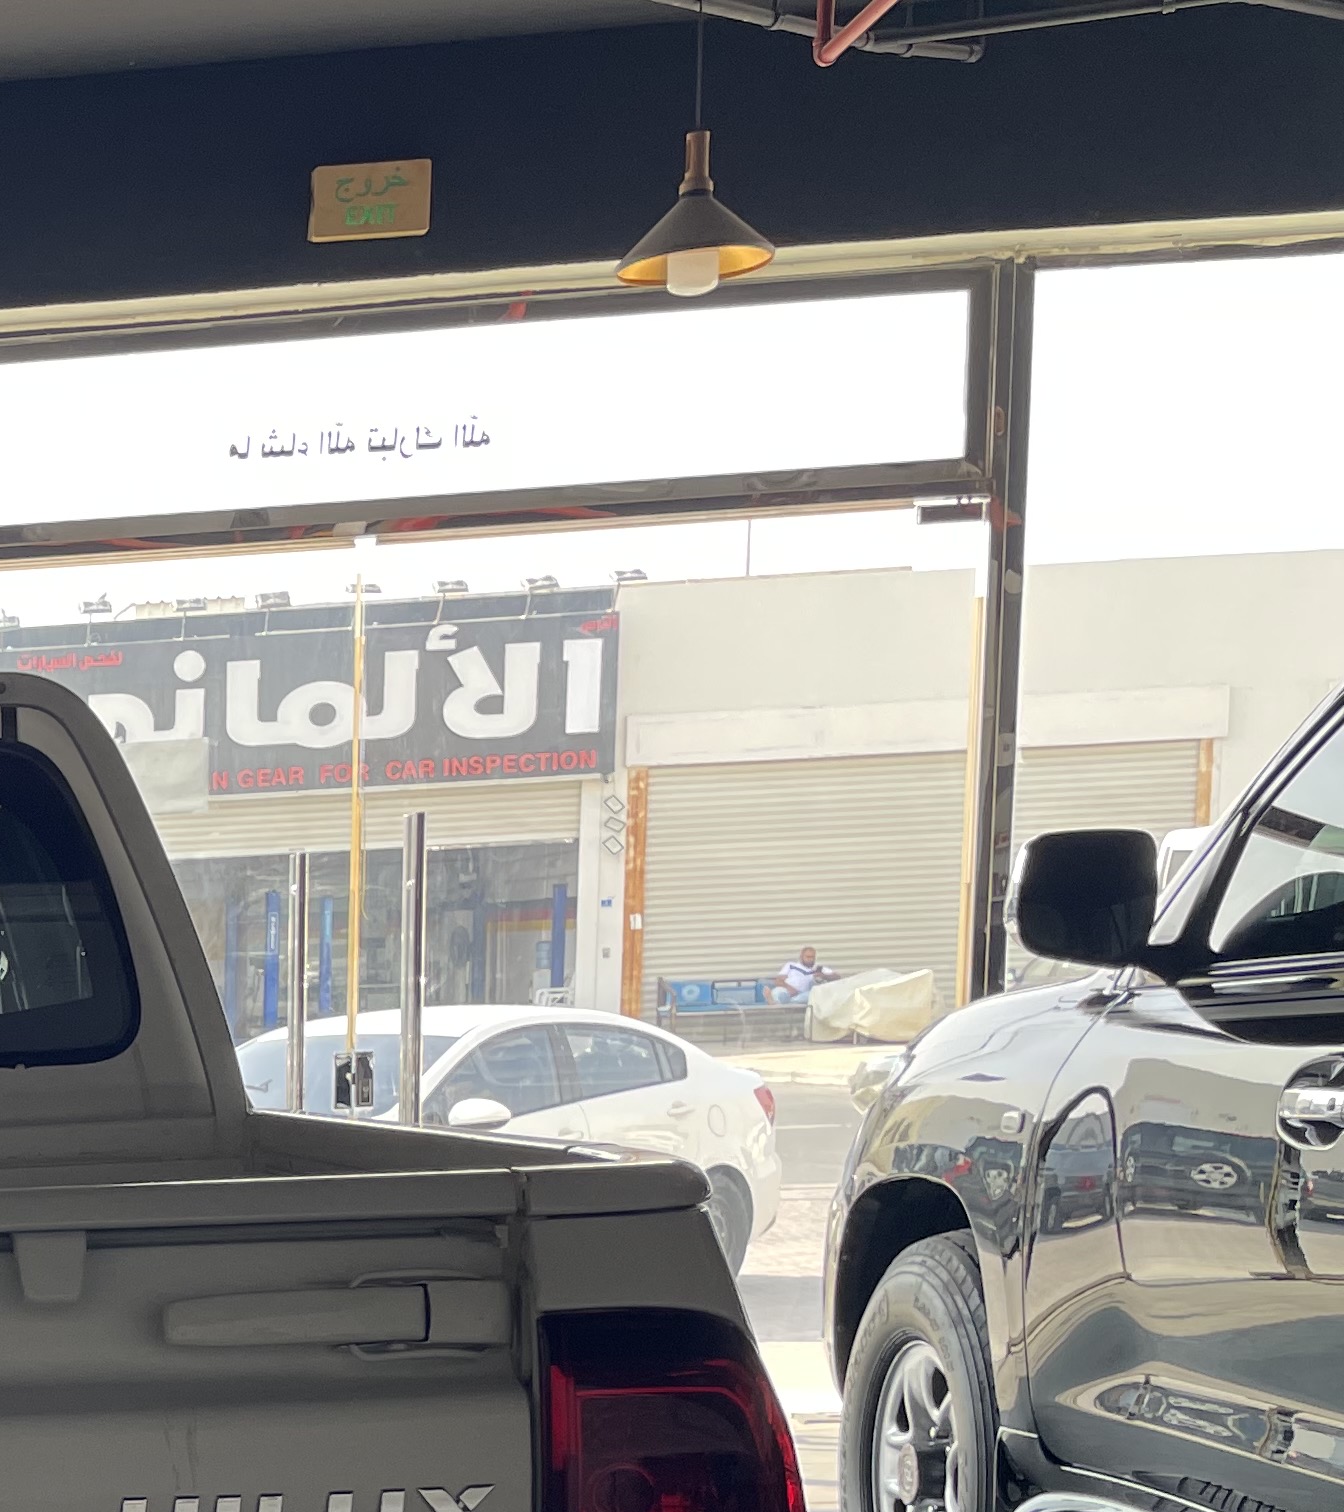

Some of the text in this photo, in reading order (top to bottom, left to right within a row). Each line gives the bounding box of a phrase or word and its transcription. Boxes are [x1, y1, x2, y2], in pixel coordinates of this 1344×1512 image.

[334, 166, 409, 202] خروج
[345, 204, 398, 226] EXIT
[16, 649, 124, 673] لفحص السيارات
[237, 766, 305, 789] GEAR
[319, 761, 369, 785] FOR
[385, 758, 435, 781] CAR
[442, 749, 597, 777] INSPECTION
